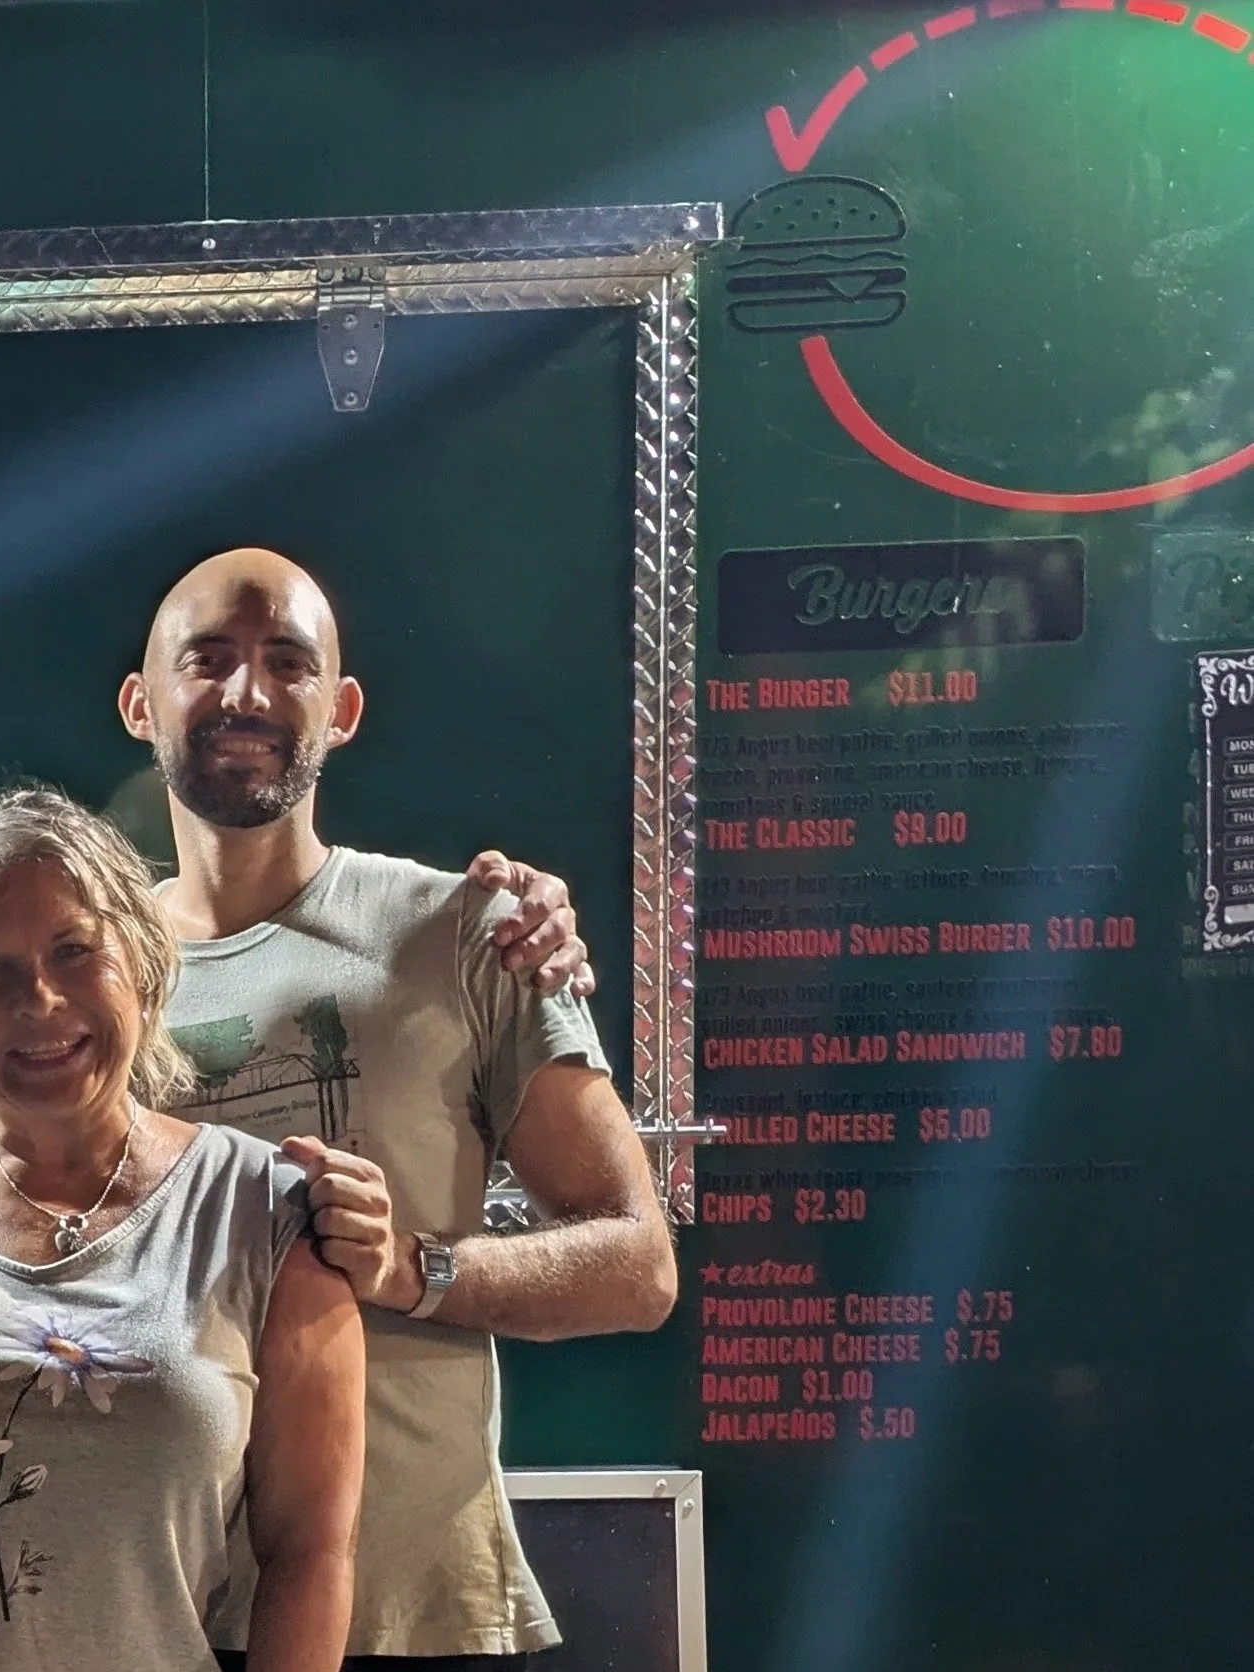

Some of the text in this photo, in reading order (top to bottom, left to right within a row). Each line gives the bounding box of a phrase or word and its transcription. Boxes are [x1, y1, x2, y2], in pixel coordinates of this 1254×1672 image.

[707, 670, 977, 711] THE BURGER $11.00
[705, 811, 967, 851] THE CLASSIC $9.00
[703, 916, 1136, 960] MUSHROOM SWISS BURGER $10.00
[703, 1037, 804, 1070] CHICKEN
[812, 1033, 888, 1066] SALAD
[895, 1030, 1027, 1063] SANDWICH
[703, 1107, 991, 1146] RILLED CHEESE $5.00
[702, 1188, 867, 1225] CHIPS $2.30
[726, 1260, 817, 1288] extras
[701, 1288, 1015, 1328] PROVOLONE CHEESE $.75
[701, 1328, 1002, 1366] AMERICAN CHEESE $.75
[701, 1368, 876, 1404] BACON $1.00
[701, 1403, 917, 1443] JALAPEÑOS $.50
